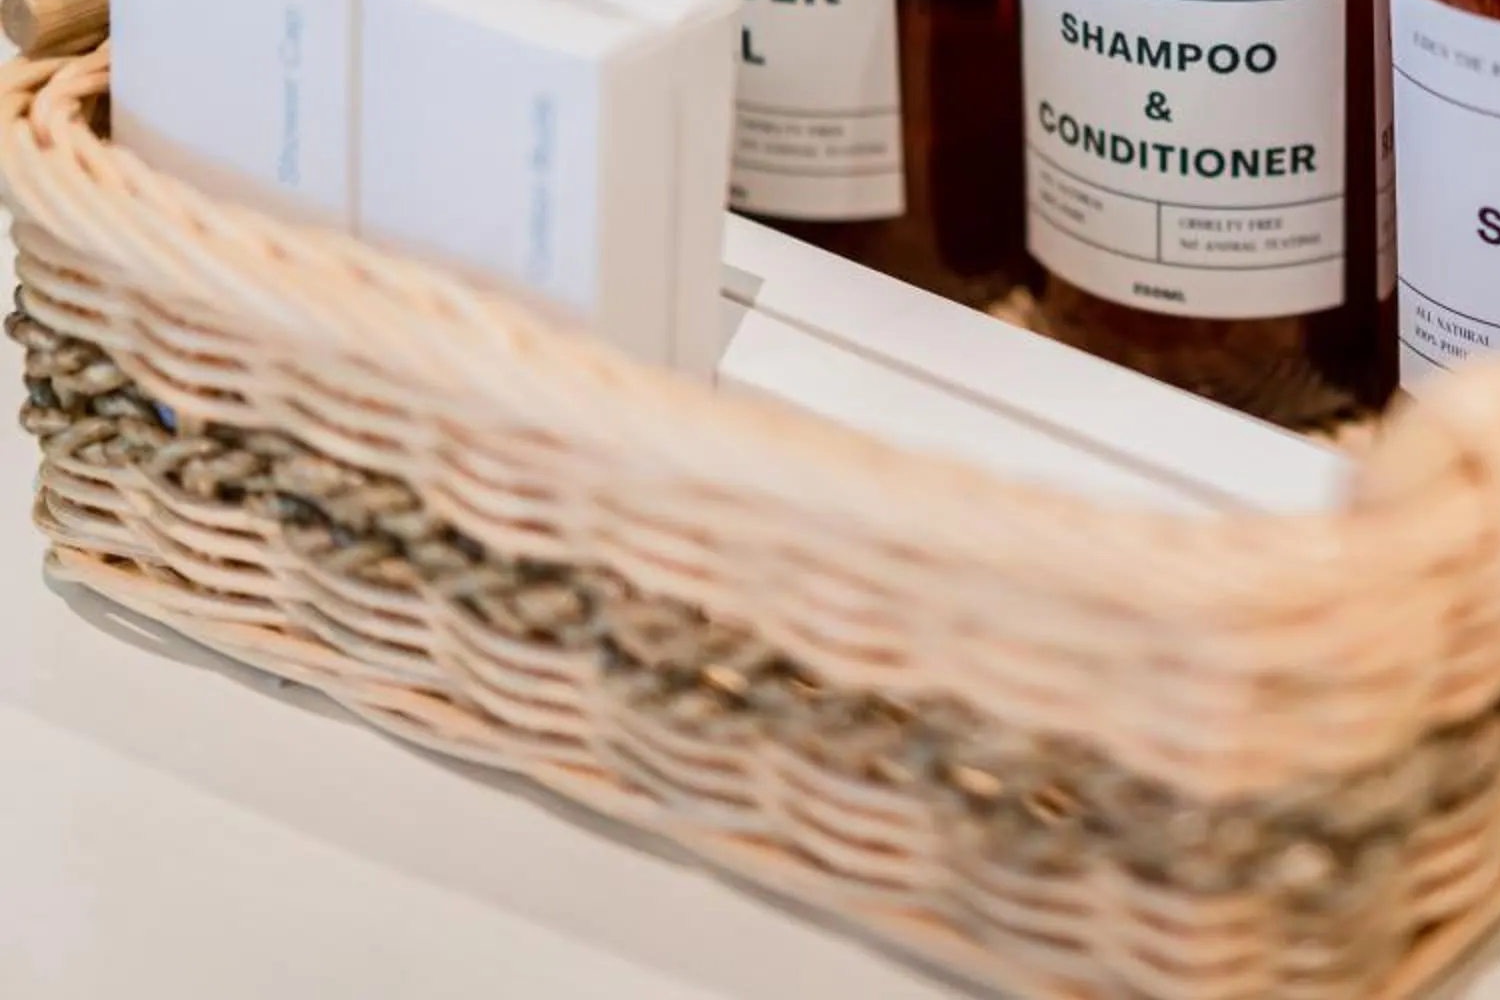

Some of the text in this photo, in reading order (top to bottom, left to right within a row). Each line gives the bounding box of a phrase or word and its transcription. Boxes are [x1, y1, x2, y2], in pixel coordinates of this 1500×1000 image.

[1060, 11, 1279, 75] SHAMPOO
[1144, 90, 1173, 122] &
[1038, 100, 1318, 179] CONDITIONER
